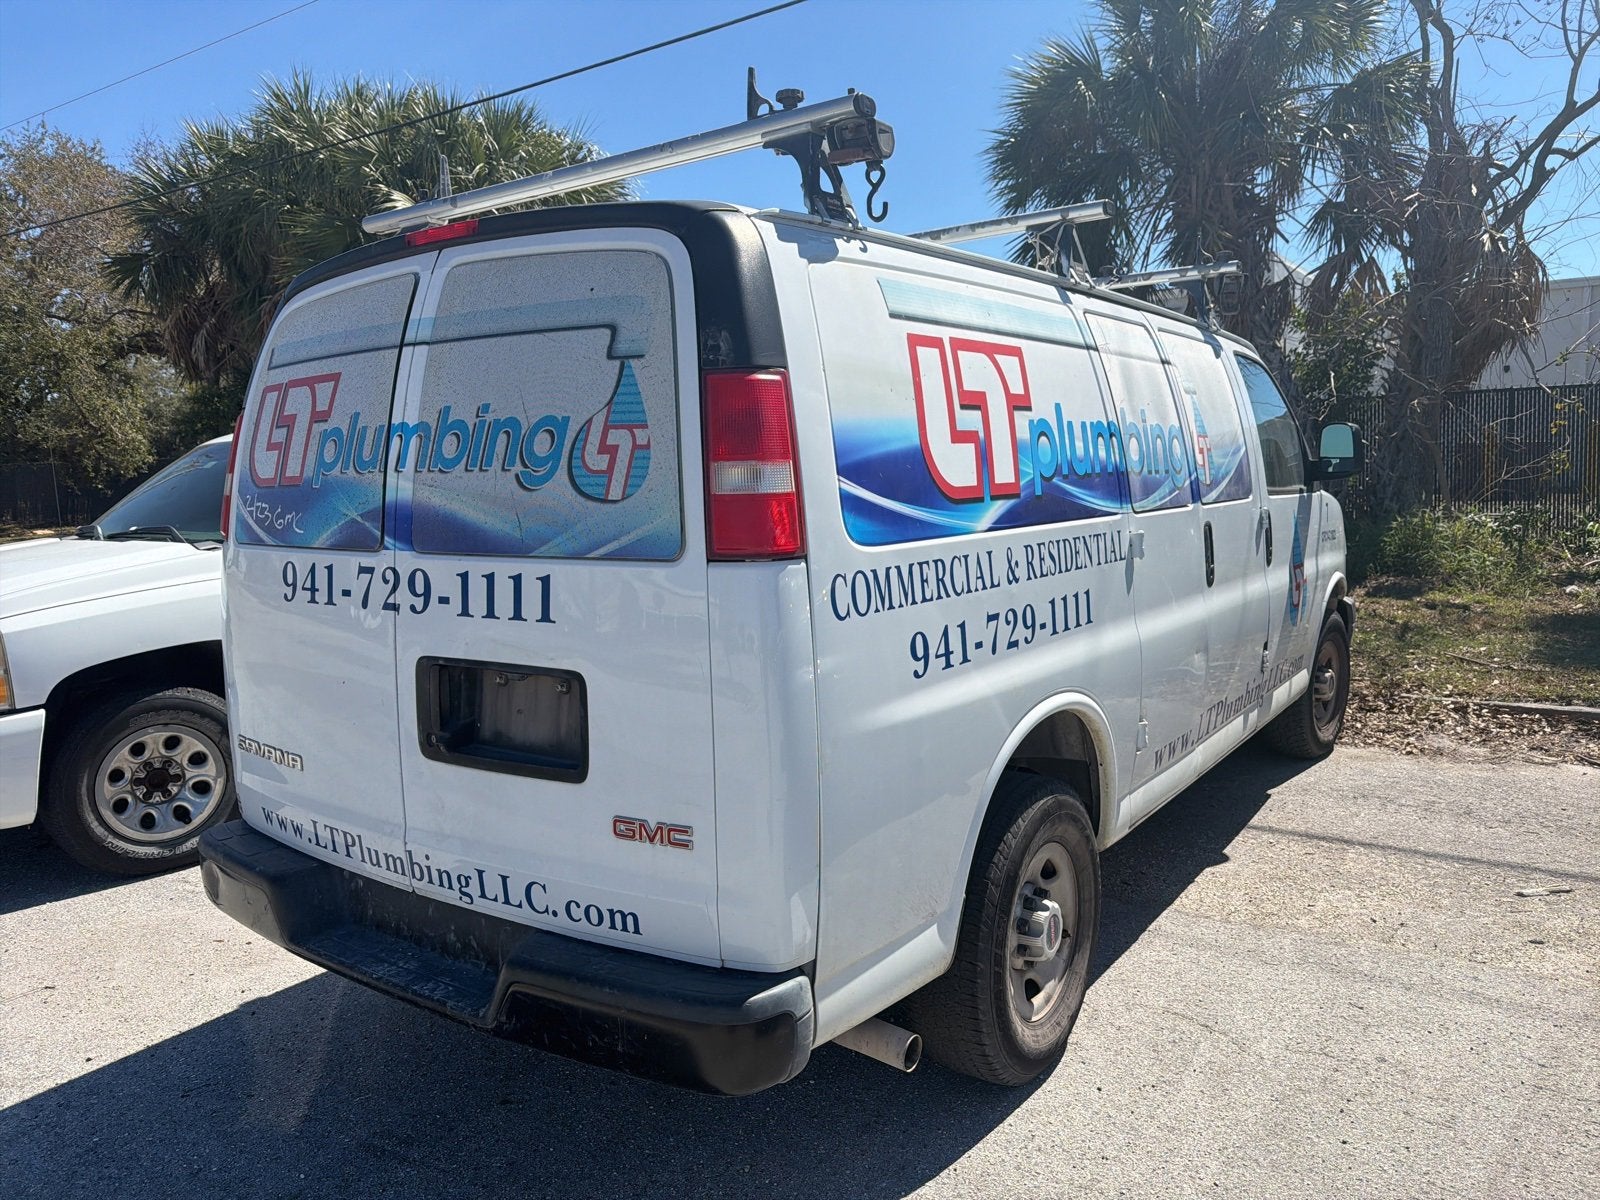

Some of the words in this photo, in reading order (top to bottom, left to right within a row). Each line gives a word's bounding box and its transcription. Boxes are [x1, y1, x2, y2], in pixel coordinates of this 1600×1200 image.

[249, 371, 343, 488] LT
[311, 403, 572, 490] plumbing
[907, 332, 1032, 502] LT
[1029, 402, 1187, 497] plumbing
[282, 560, 557, 624] 941-729-1111
[830, 550, 1000, 622] COMMERCIAL
[1006, 560, 1021, 586] &
[1025, 530, 1128, 581] RESIDENTIAL
[910, 588, 1094, 680] 941-729-1111
[238, 734, 304, 772] SAVANA
[261, 806, 643, 936] www.LTPlumbingLLC.com
[612, 815, 694, 851] GMC
